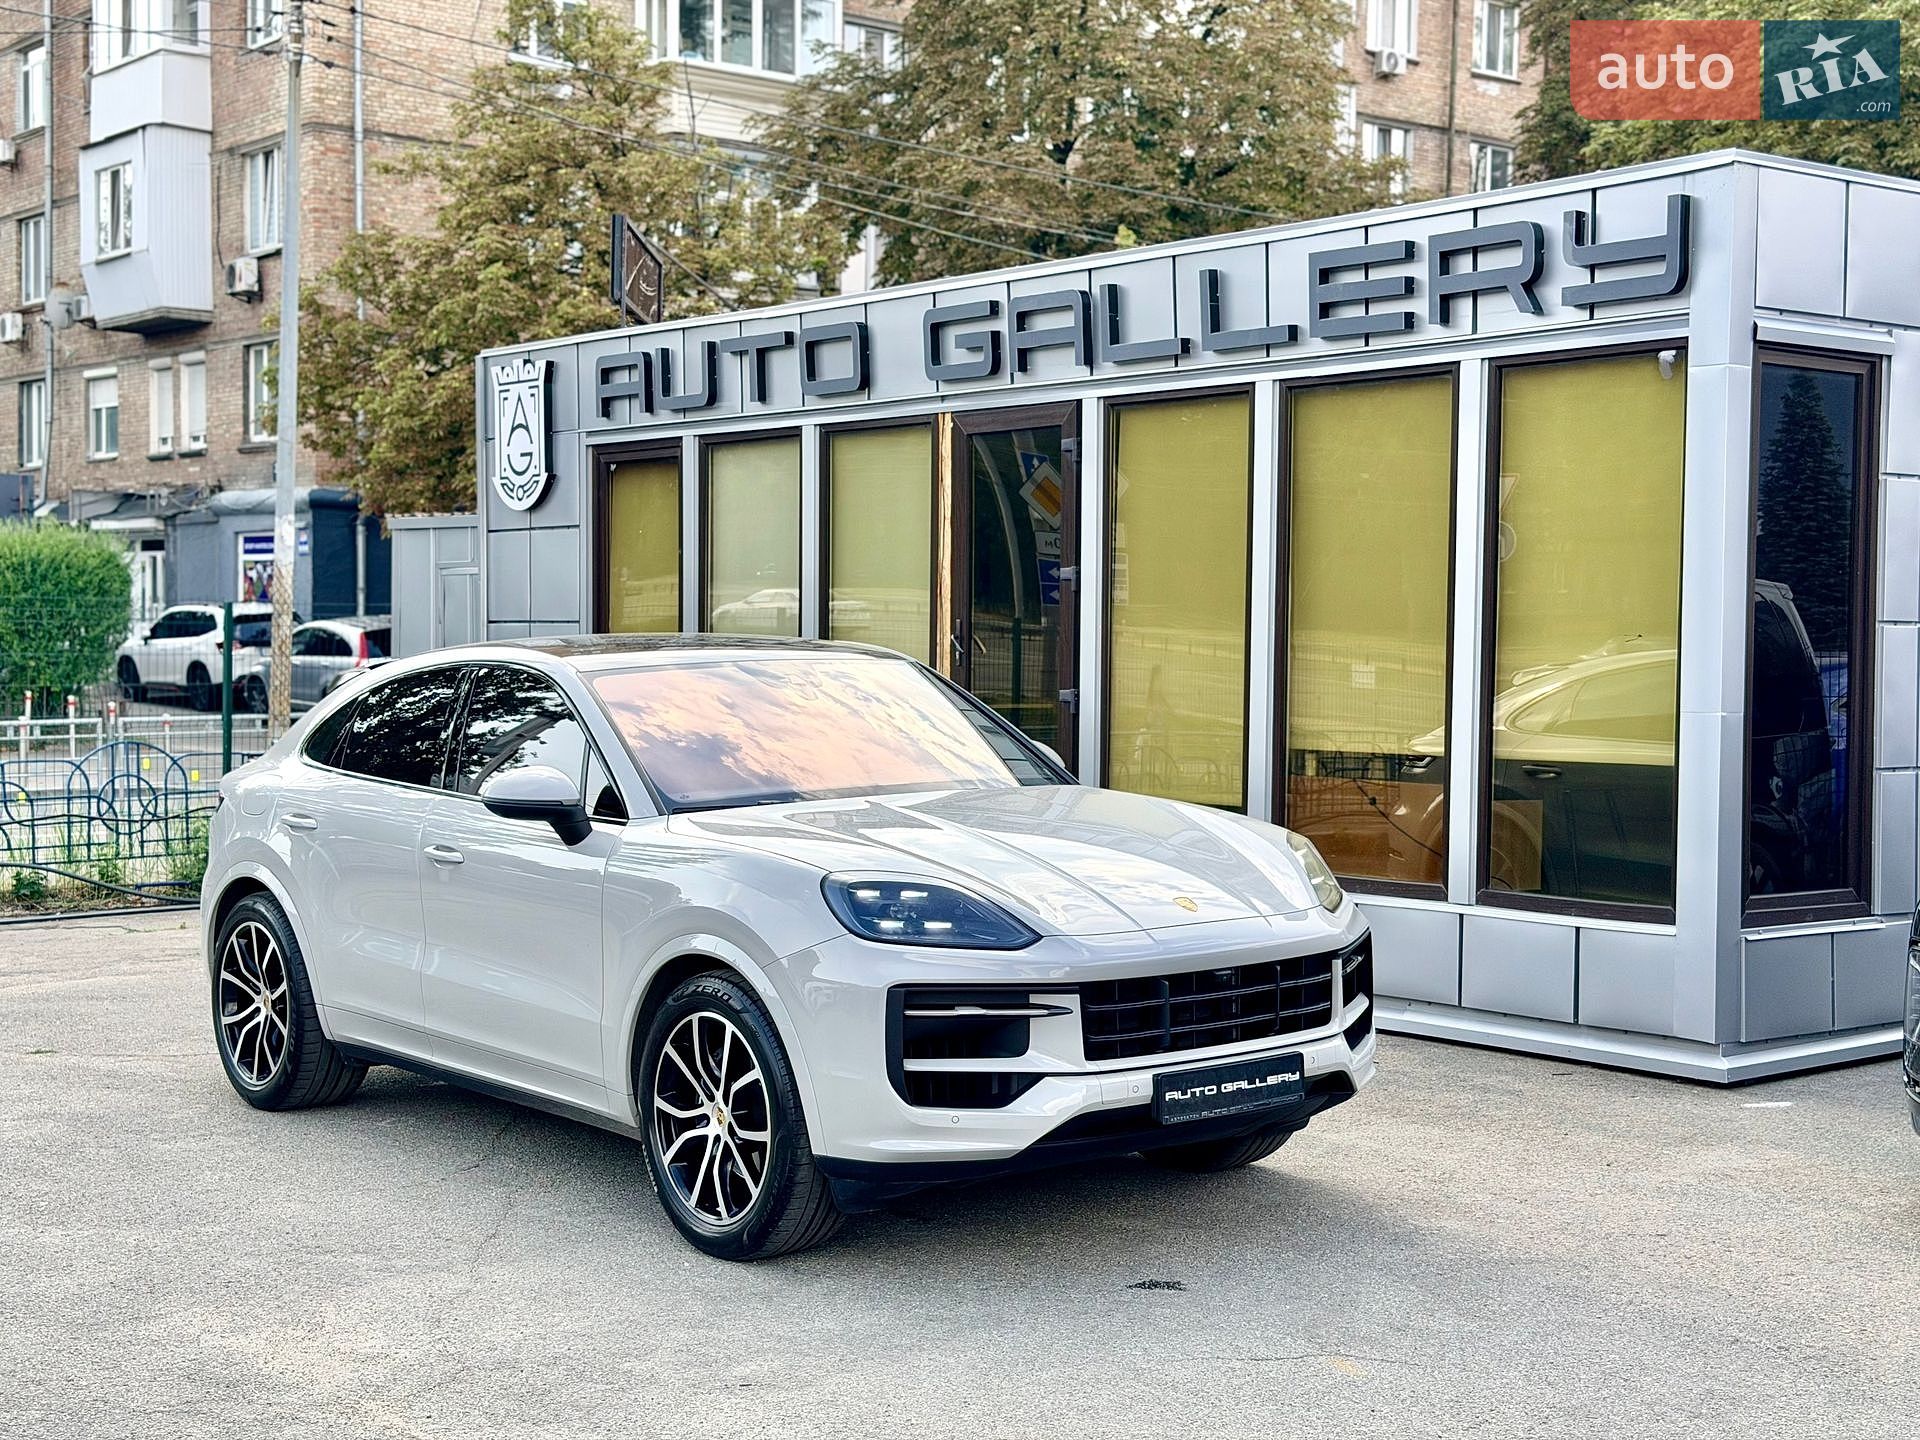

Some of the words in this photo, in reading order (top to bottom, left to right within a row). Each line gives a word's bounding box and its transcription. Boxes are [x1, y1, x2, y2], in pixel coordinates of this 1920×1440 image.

[595, 321, 869, 418] AUTO
[923, 193, 1690, 381] GALLERY
[692, 984, 733, 1003] ZERO
[1165, 1085, 1217, 1102] AUTO
[1221, 1070, 1300, 1093] GALLERY
